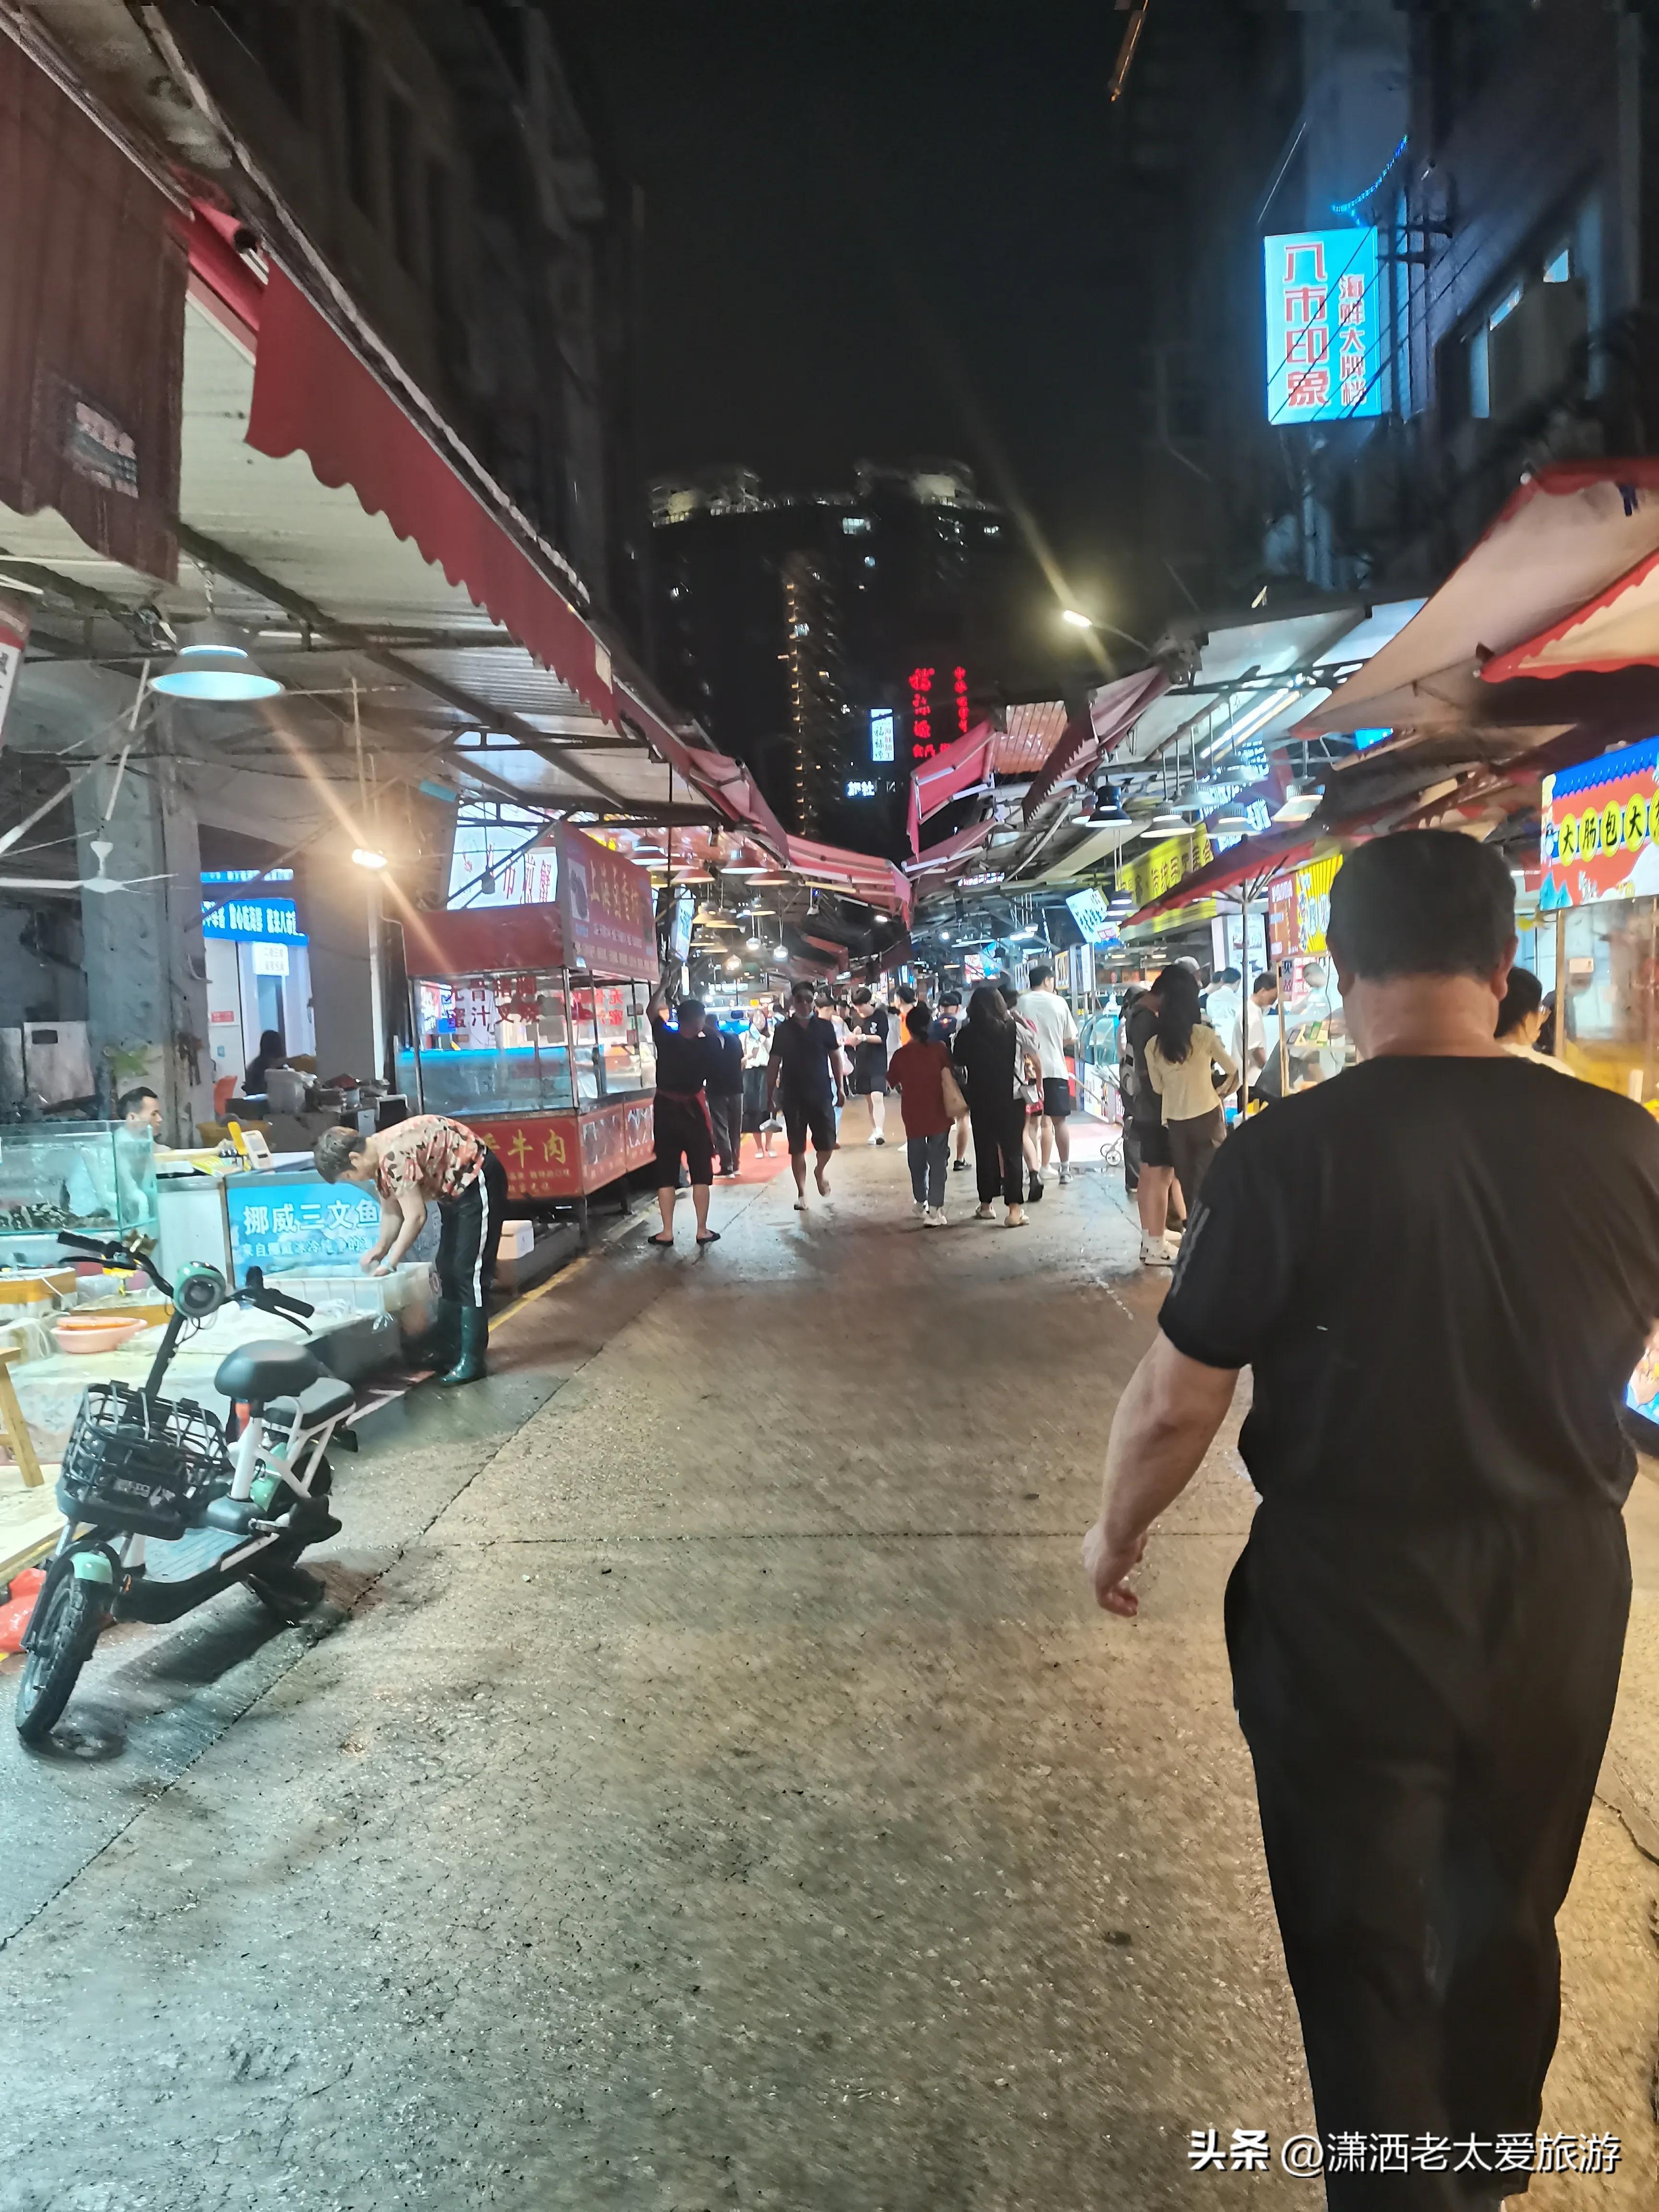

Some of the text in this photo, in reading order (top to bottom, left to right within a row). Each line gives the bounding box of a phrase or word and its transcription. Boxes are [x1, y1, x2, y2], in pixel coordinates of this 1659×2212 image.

[1284, 241, 1330, 407] 八市印象
[242, 1198, 380, 1236] 挪威三文鱼
